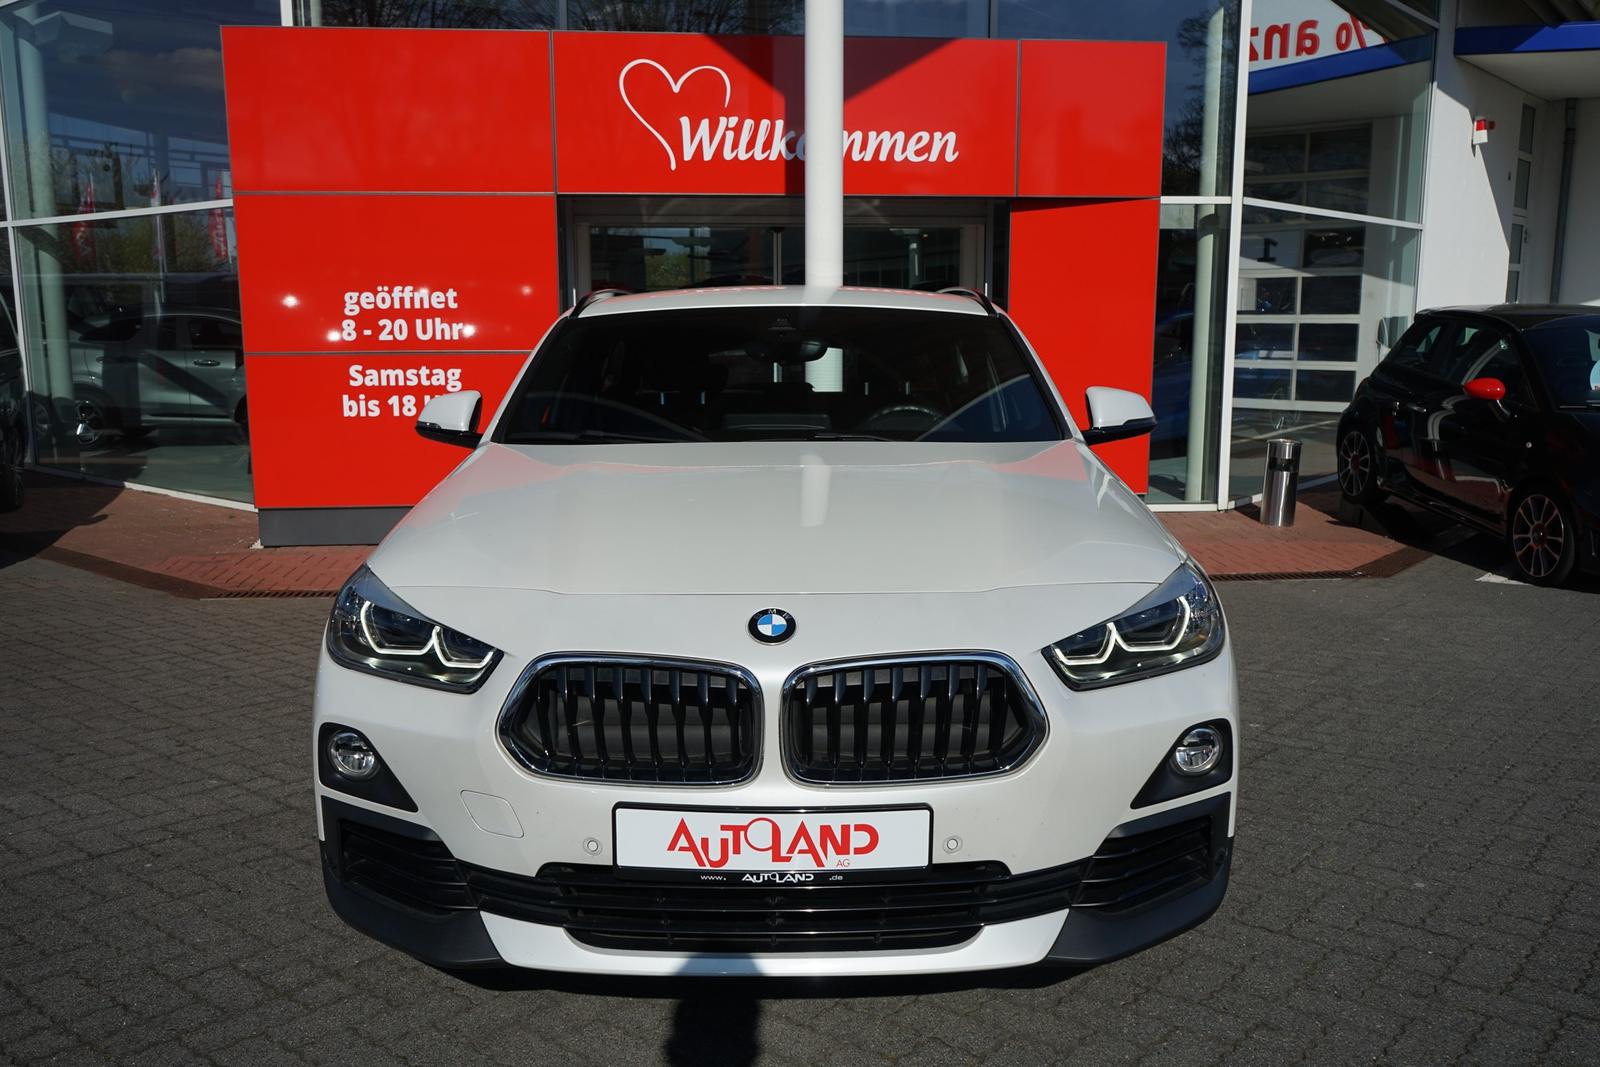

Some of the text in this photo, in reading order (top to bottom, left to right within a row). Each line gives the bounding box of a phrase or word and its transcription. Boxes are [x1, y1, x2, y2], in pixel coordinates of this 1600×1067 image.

[343, 286, 458, 316] geöffnet
[341, 319, 357, 341] 8
[378, 318, 408, 341] 20
[415, 317, 464, 341] Uhr
[348, 364, 462, 392] Samstag
[342, 394, 380, 417] bis
[387, 394, 417, 417] 18
[836, 858, 851, 868] AG
